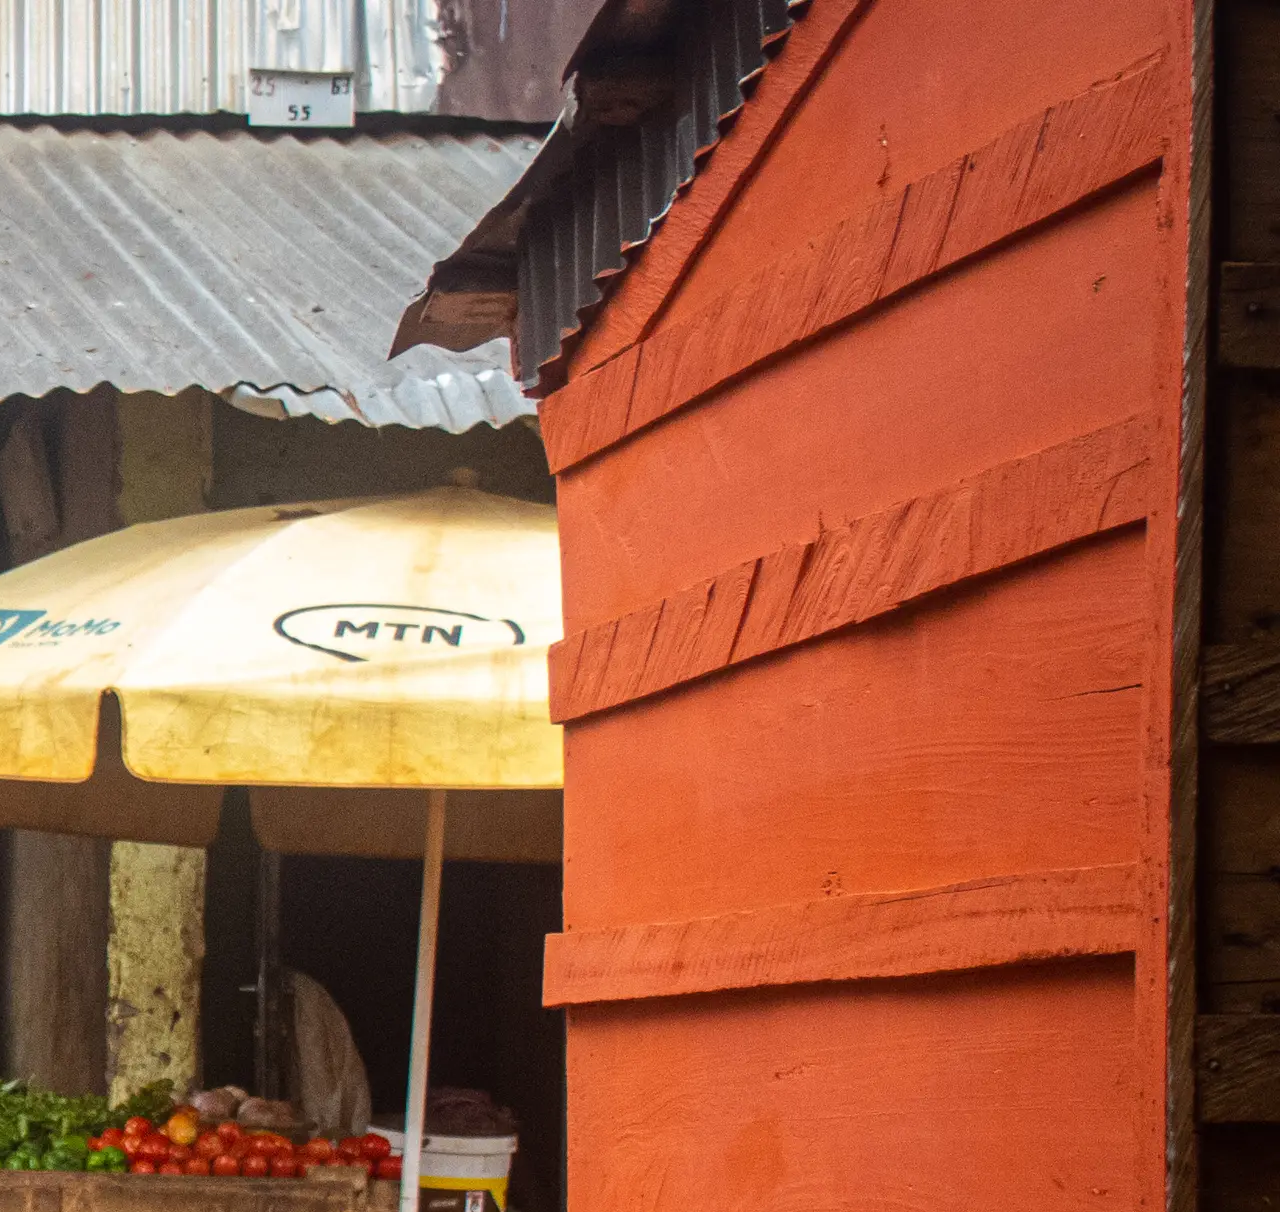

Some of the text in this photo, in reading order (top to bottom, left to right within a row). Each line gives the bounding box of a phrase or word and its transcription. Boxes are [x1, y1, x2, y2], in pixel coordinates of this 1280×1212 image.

[288, 104, 311, 121] 55
[23, 618, 121, 638] MoMo
[334, 620, 463, 647] MTN
